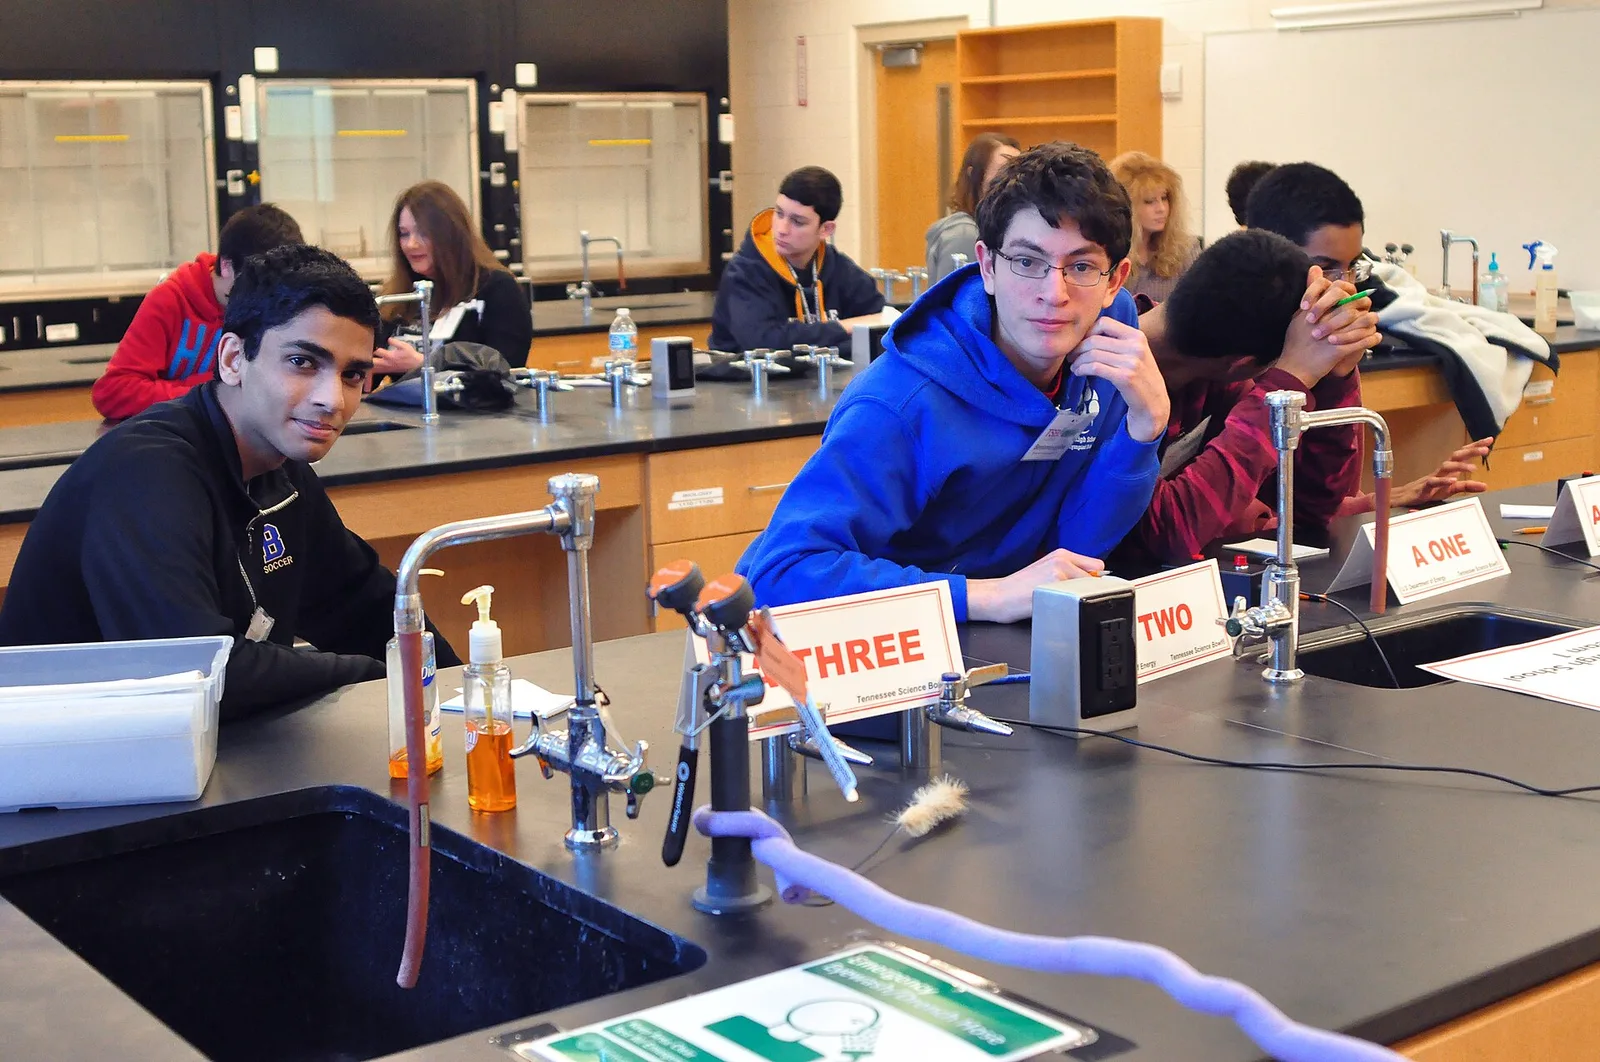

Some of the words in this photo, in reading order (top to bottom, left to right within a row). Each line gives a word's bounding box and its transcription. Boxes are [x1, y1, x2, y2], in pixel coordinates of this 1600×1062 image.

[263, 523, 286, 564] B
[1411, 545, 1429, 568] A
[1428, 533, 1472, 562] ONE
[263, 555, 294, 574] SOCCER
[1137, 603, 1193, 641] TWO
[1170, 649, 1195, 661] Tennessee
[1194, 643, 1212, 655] Science
[1140, 660, 1157, 671] Energy
[1503, 664, 1574, 683] School
[857, 690, 897, 704] Tennessee
[898, 684, 927, 696] Science
[847, 954, 939, 996] Emergency
[958, 1017, 1007, 1046] Hose
